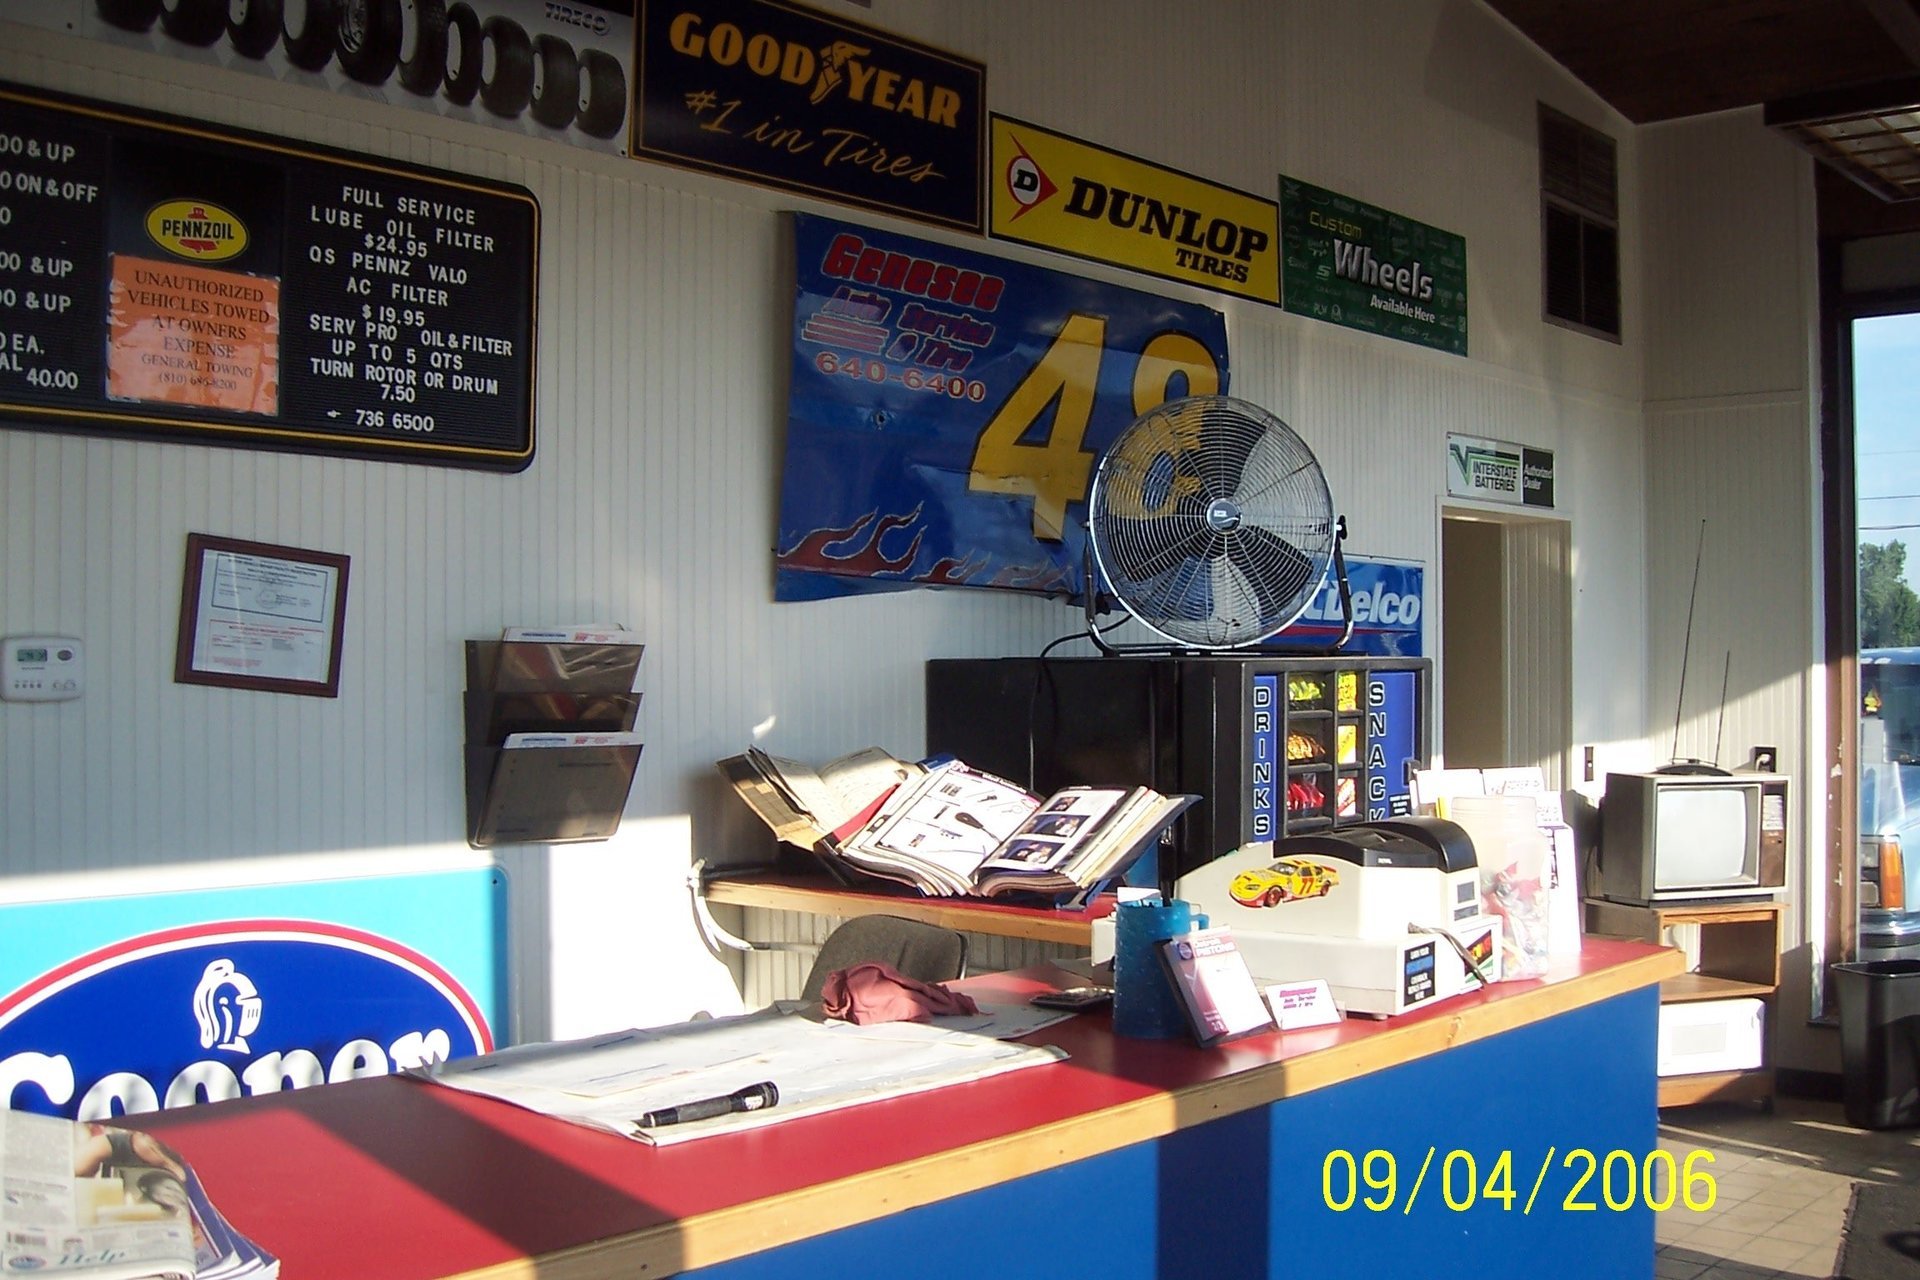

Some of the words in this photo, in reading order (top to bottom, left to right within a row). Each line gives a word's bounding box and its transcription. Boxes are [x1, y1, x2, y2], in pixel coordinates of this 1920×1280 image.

[28, 139, 40, 157] &
[47, 142, 75, 163] UP
[685, 90, 741, 134] #1
[744, 115, 813, 155] in
[822, 128, 945, 184] Tires
[16, 173, 42, 195] ON
[62, 182, 98, 203] OFF
[1013, 169, 1038, 193] D
[343, 186, 384, 209] FULL
[397, 197, 475, 225] SERVICE
[1063, 176, 1269, 263] DUNLOP
[162, 219, 235, 241] PENNZOIL
[311, 205, 363, 229] LUBE
[387, 219, 416, 239] OIL
[436, 228, 494, 252] FILTER
[1309, 210, 1362, 238] Custom
[365, 233, 428, 258] $24.95
[31, 256, 44, 273] &
[48, 258, 73, 277] UP
[309, 246, 335, 265] QS
[352, 252, 411, 276] PENNZ
[429, 264, 467, 285] VALO
[820, 233, 1005, 312] Genesee
[1175, 247, 1250, 284] TIRES
[1333, 238, 1434, 302] Wheels
[135, 270, 264, 302] UNAUTHORIZED
[347, 277, 371, 295] AC
[391, 284, 448, 306] FILTER
[26, 291, 39, 309] &
[44, 293, 71, 313] UP
[128, 290, 209, 314] VEHICLES
[214, 302, 270, 324] TOWED
[1370, 294, 1414, 318] Available
[1414, 306, 1436, 324] Here
[152, 315, 175, 329] AT
[179, 318, 246, 340] OWNERS
[309, 314, 356, 336] SERV
[366, 322, 397, 341] PRO
[421, 330, 444, 347] OIL
[462, 335, 513, 356] FILTER
[164, 336, 236, 358] EXPENSE
[332, 339, 356, 357] UP
[369, 344, 392, 361] TO
[407, 349, 416, 364] 5
[430, 352, 463, 371] QTS
[26, 368, 78, 390] 40.00
[142, 354, 201, 371] GENERAL
[206, 361, 253, 378] TOWING
[311, 358, 353, 378] TURN
[366, 366, 416, 386] ROTOR
[424, 372, 444, 389] OR
[452, 375, 498, 395] DRUM
[816, 352, 986, 402] 640-6400
[381, 384, 415, 403] 7.50
[355, 409, 384, 427] 736
[392, 413, 434, 432] 6500
[1473, 461, 1518, 479] INTERSTATE
[1475, 475, 1515, 492] BATTERIES
[1254, 686, 1271, 836] DRINKS
